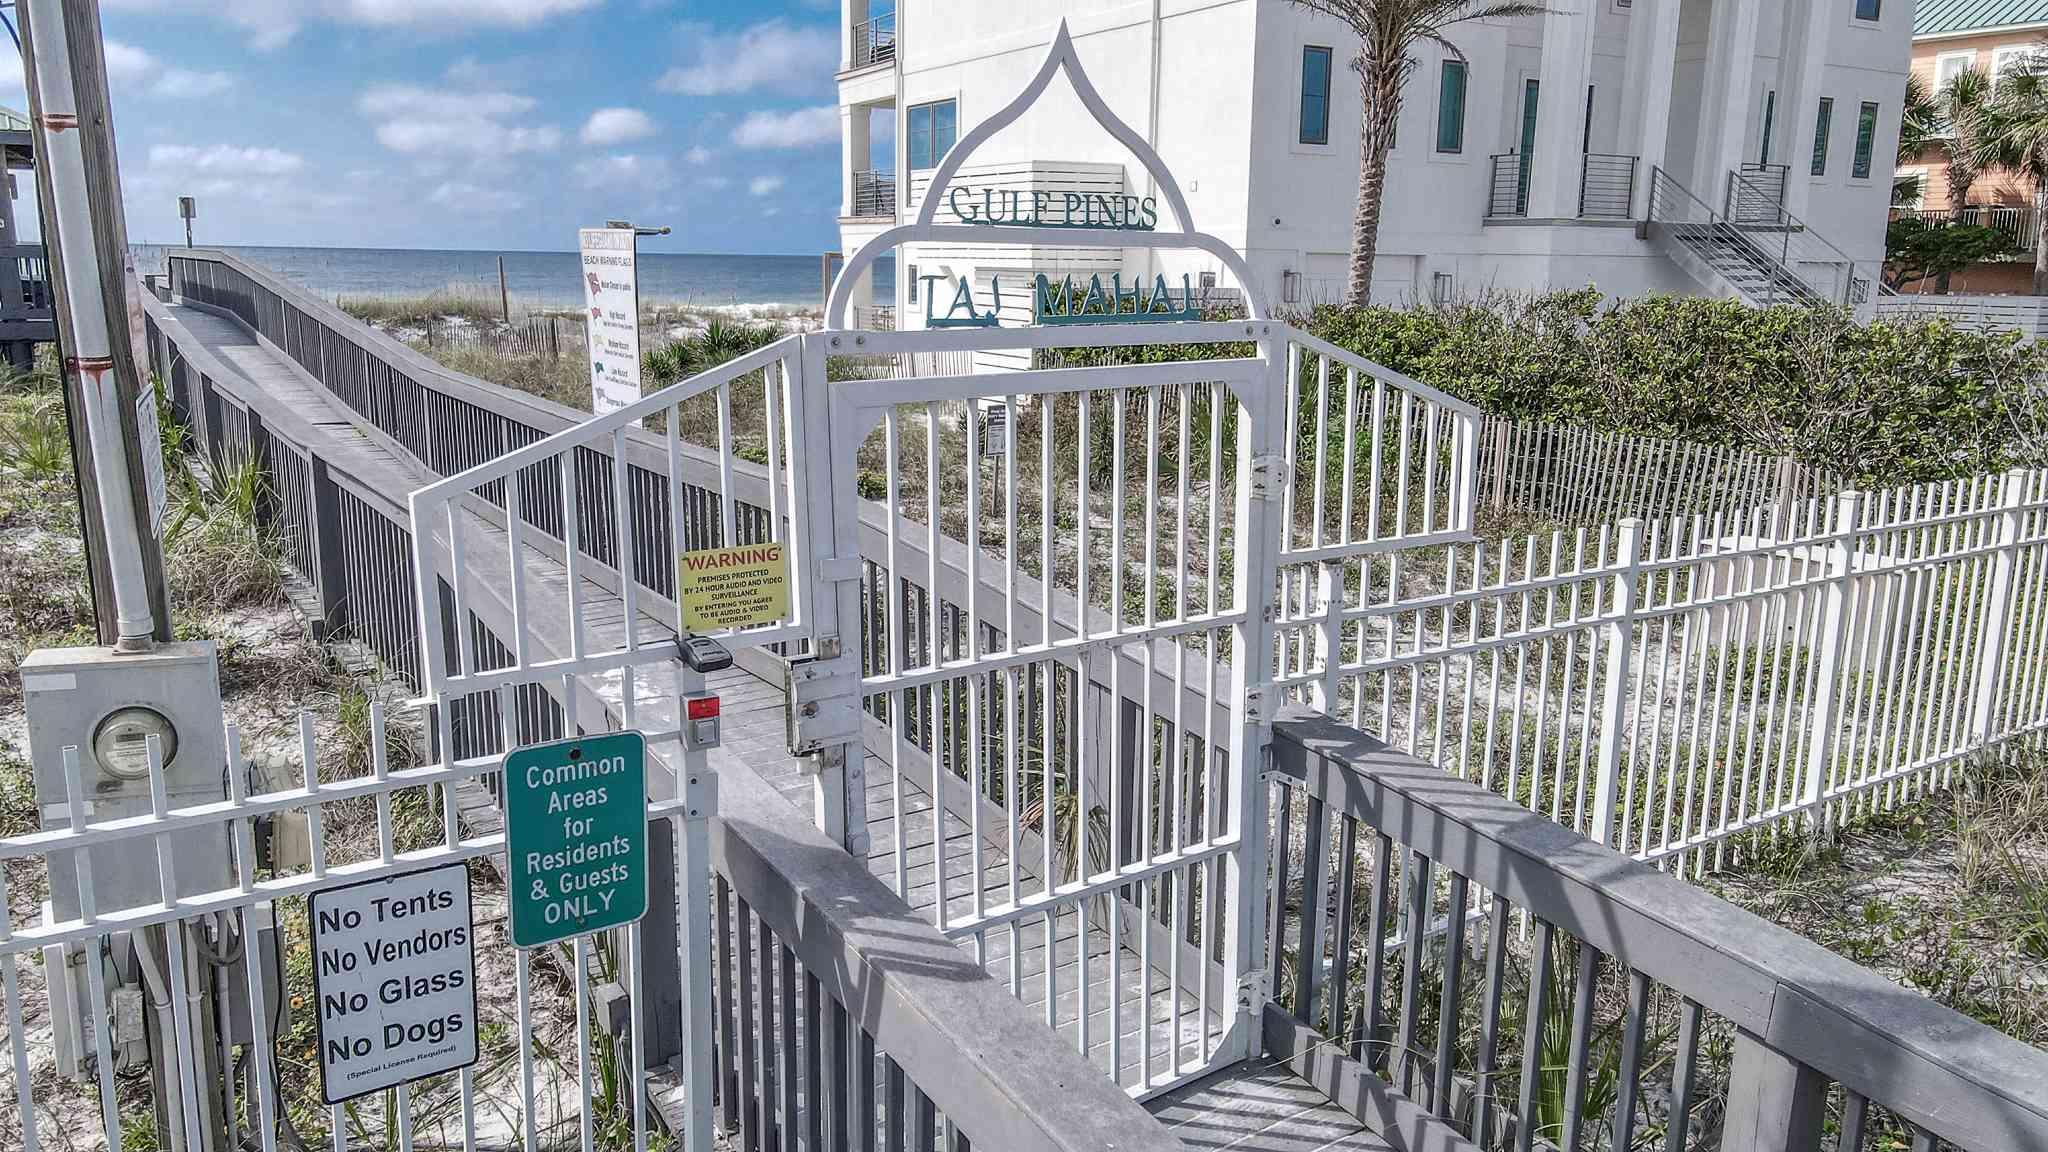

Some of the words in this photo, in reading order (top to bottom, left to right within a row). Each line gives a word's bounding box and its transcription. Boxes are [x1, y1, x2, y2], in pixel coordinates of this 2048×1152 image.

[950, 187, 1050, 225] GULF
[1064, 192, 1157, 230] PINES
[919, 272, 1000, 322] TAJ
[1036, 271, 1202, 320] MAHAL
[687, 547, 779, 571] WARNING
[684, 587, 694, 595] BY
[695, 585, 704, 594] 24
[705, 583, 724, 593] HOUR
[726, 580, 747, 591] AUDIO
[748, 579, 762, 588] AND
[763, 576, 783, 585] VIDEO
[697, 573, 730, 584] PREMISES
[731, 569, 769, 580] PROTECTED
[705, 600, 737, 611] ENTERING
[739, 599, 751, 607] YOU
[753, 596, 773, 604] AGREE
[711, 588, 758, 601] SURVEILLANCE
[720, 608, 741, 617] AUDIO
[750, 605, 769, 613] VIDEO
[718, 614, 752, 624] RECORDED
[526, 755, 625, 788] Common
[548, 787, 608, 815] Areas
[563, 817, 594, 839] for
[527, 834, 630, 874] Residents
[530, 879, 550, 901] &
[559, 862, 629, 894] Guests
[319, 908, 361, 935] No
[370, 887, 453, 922] Tents
[544, 888, 615, 924] ONLY
[322, 948, 357, 977] No
[364, 926, 466, 966] Vendors
[325, 991, 368, 1020] No
[379, 969, 465, 1005] Glass
[328, 1036, 372, 1065] No
[383, 1012, 463, 1050] Dogs
[346, 1065, 381, 1081] (Special
[383, 1056, 416, 1070] License
[417, 1044, 457, 1060] Required)
